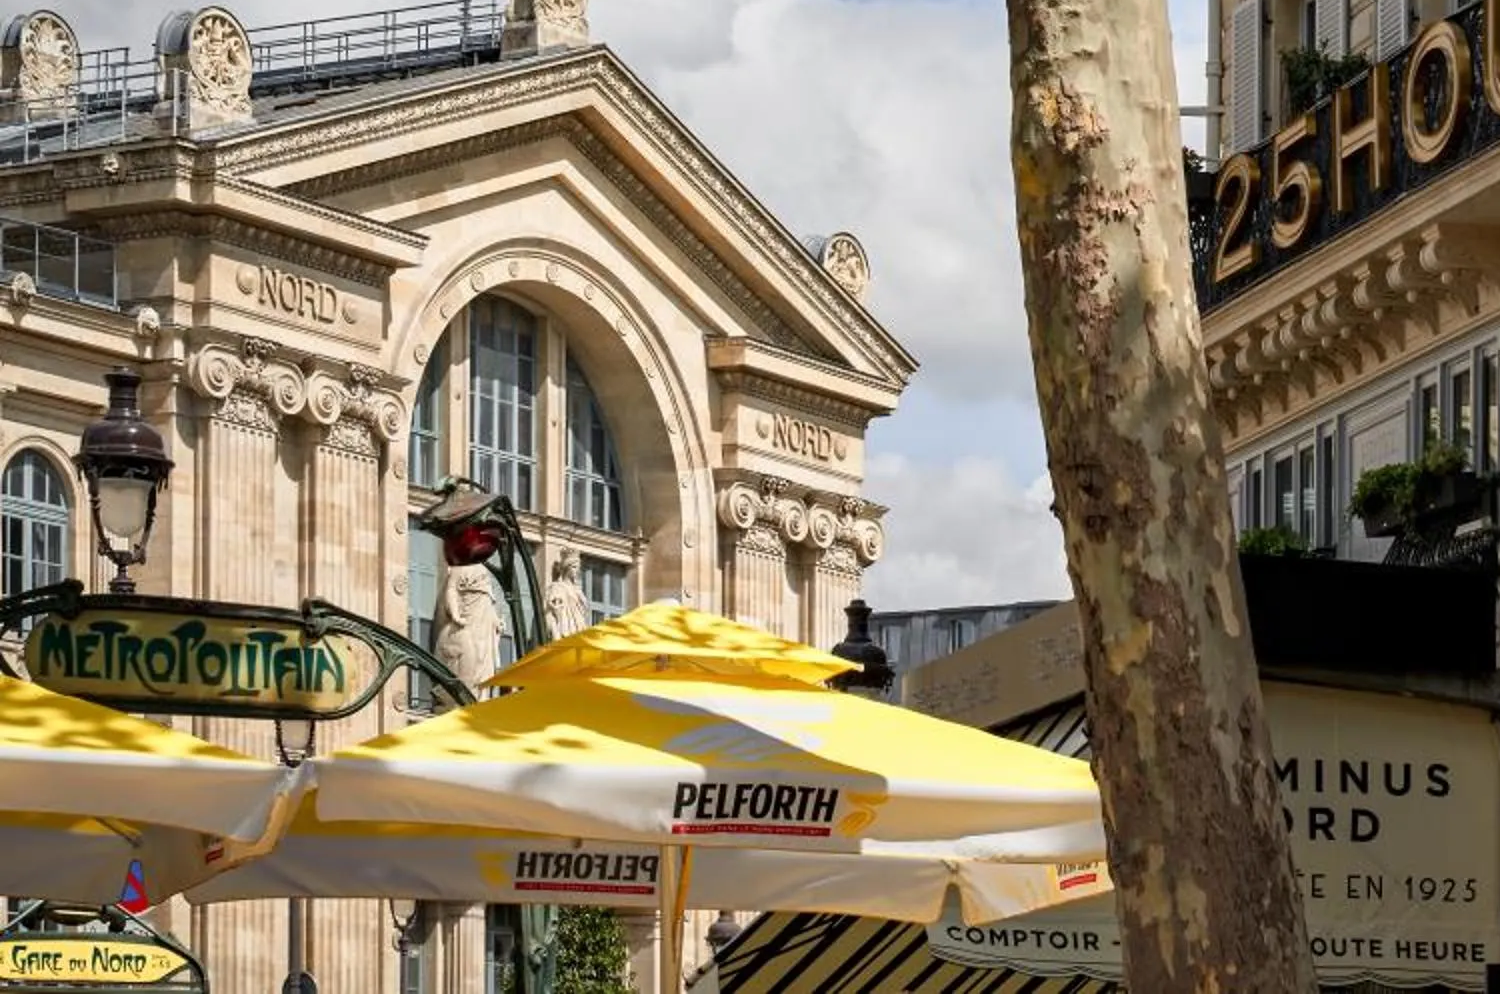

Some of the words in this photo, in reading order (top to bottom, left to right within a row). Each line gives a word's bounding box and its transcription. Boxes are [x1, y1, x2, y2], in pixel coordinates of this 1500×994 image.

[258, 265, 338, 324] NORD
[772, 412, 832, 462] NORD
[40, 620, 345, 699] METROPOLITAIN
[1273, 758, 1451, 798] MINUS
[673, 782, 839, 822] PELFORTH
[1282, 807, 1380, 842] RD
[1347, 874, 1384, 900] EN
[1405, 875, 1478, 903] 1925
[946, 925, 1100, 951] COMPTOIR
[1310, 937, 1384, 958] OUTE
[1395, 940, 1486, 963] HEURE
[10, 945, 64, 976] GARE
[91, 946, 147, 978] NORD
